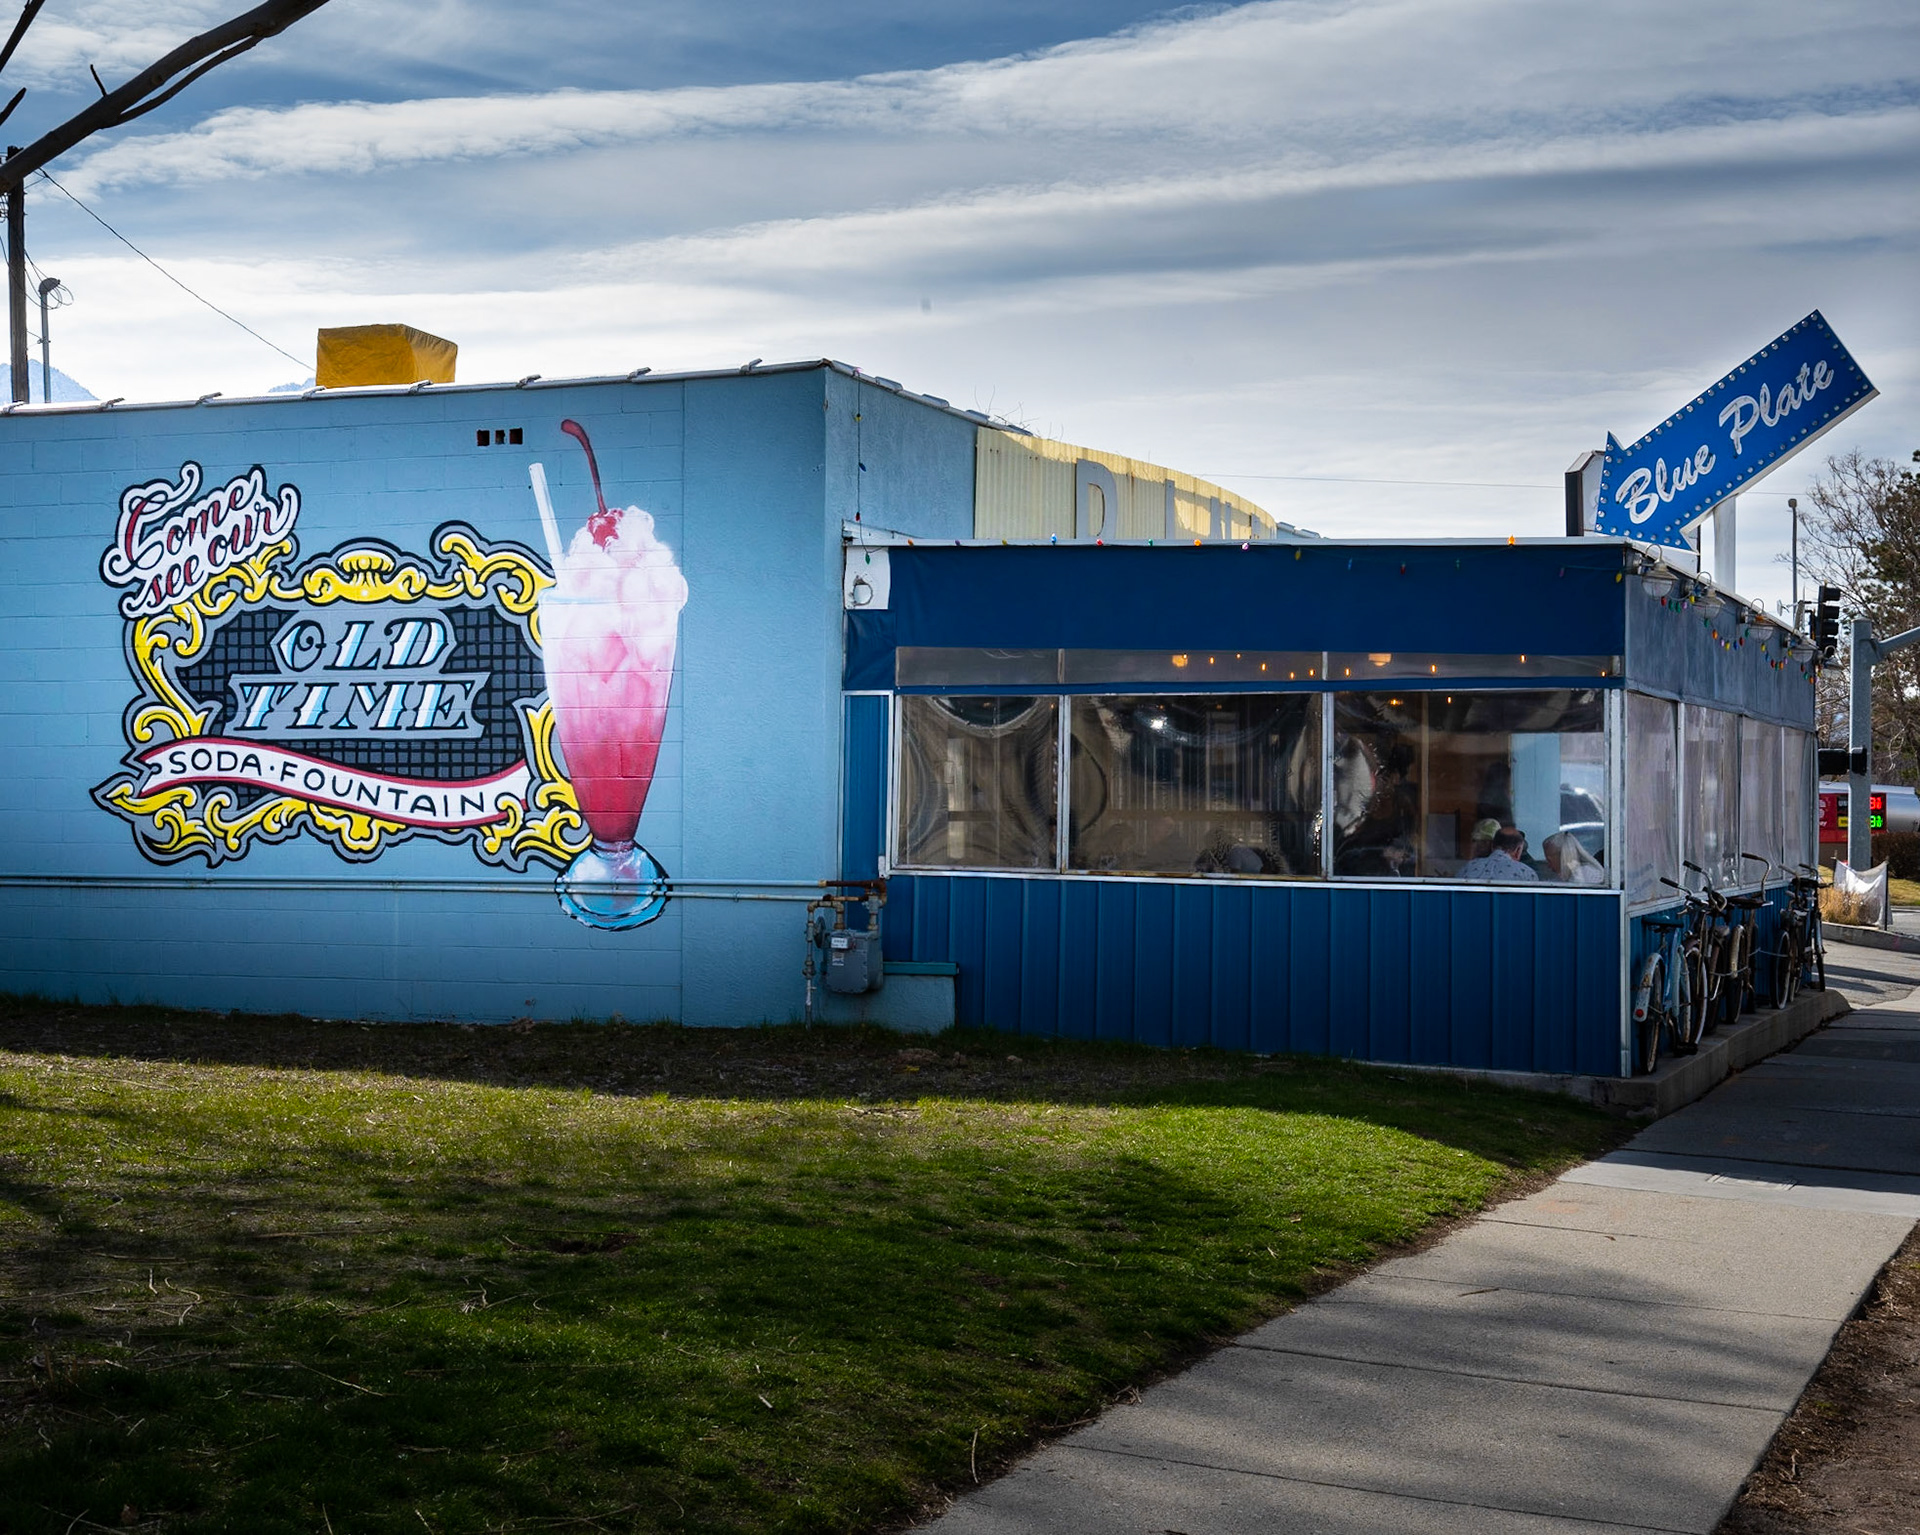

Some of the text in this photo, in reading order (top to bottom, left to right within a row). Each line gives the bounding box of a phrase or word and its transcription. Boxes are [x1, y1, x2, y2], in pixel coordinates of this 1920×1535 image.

[1615, 359, 1835, 525] Blue Plate
[108, 468, 261, 570] Come
[126, 491, 294, 608] see our
[279, 618, 449, 671] OLD
[233, 680, 473, 730] TIME
[170, 749, 486, 818] SODA FOUNTAIN
